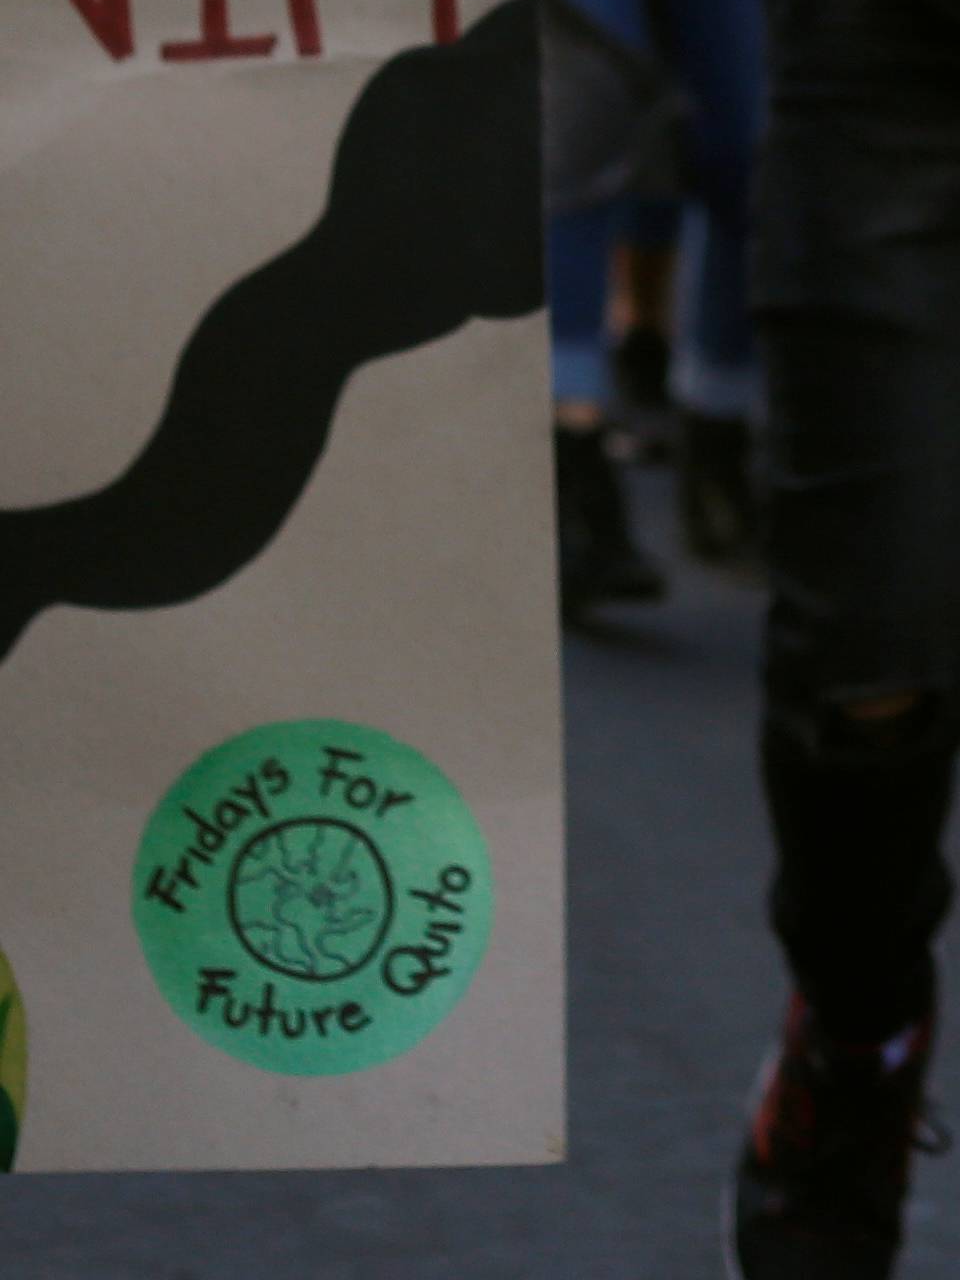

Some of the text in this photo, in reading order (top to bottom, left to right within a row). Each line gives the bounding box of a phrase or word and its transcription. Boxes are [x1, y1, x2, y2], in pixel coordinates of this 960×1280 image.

[144, 743, 416, 914] Fridays For
[194, 862, 472, 1040] Future Quito
